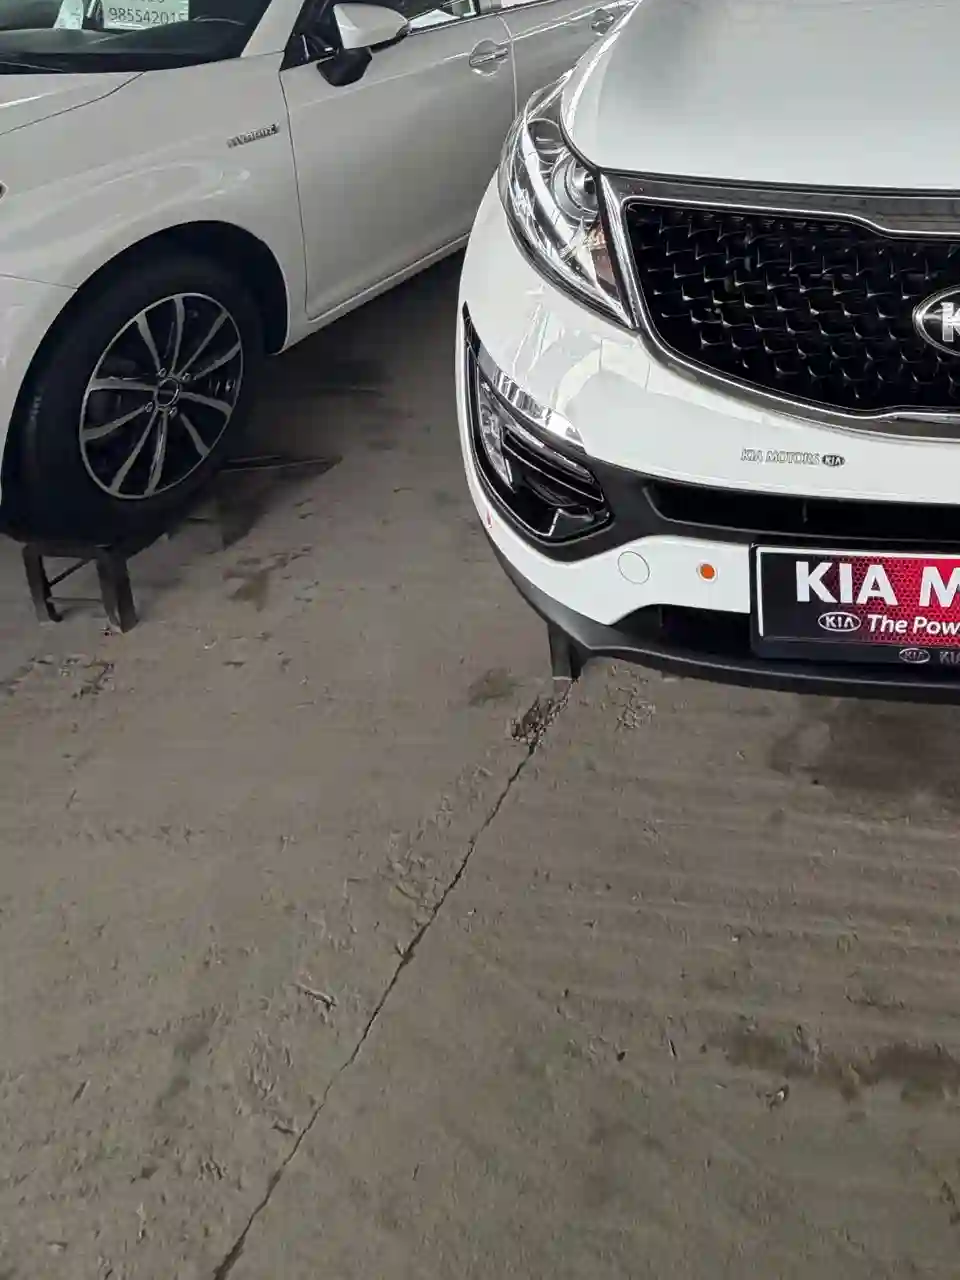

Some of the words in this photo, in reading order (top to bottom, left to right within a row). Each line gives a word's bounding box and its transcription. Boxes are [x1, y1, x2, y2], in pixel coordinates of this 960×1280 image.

[741, 448, 763, 463] KIA
[765, 450, 821, 466] MOTORS
[795, 561, 899, 606] KIA
[825, 616, 855, 629] KIA
[868, 613, 908, 634] The
